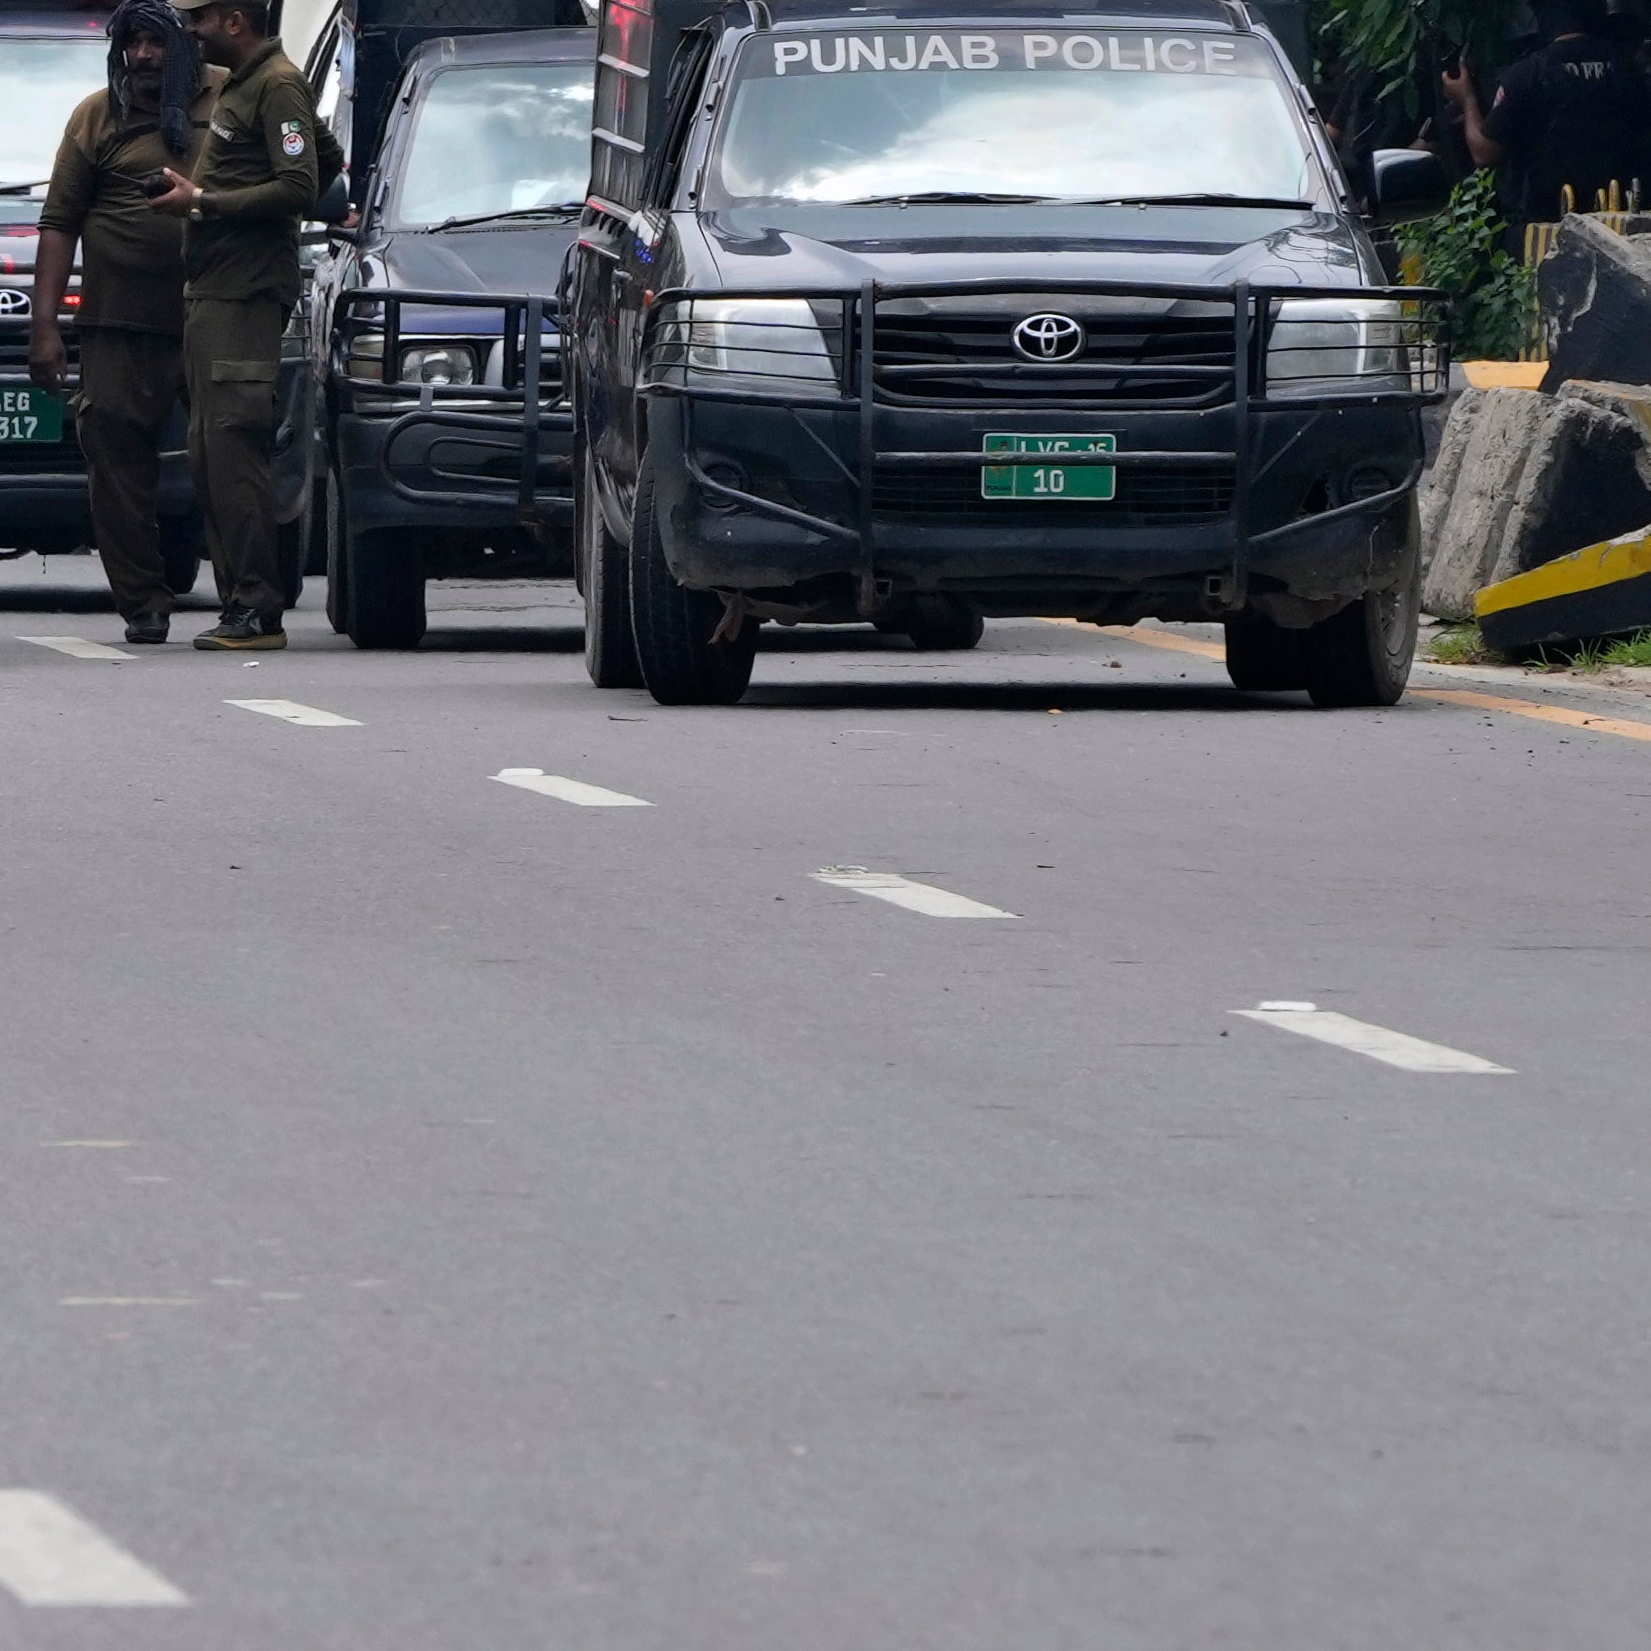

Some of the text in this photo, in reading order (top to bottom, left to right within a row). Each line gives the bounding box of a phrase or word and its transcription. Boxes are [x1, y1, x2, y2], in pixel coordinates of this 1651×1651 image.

[774, 34, 1238, 76] PUNJAB POLICE
[1033, 468, 1065, 493] 10
